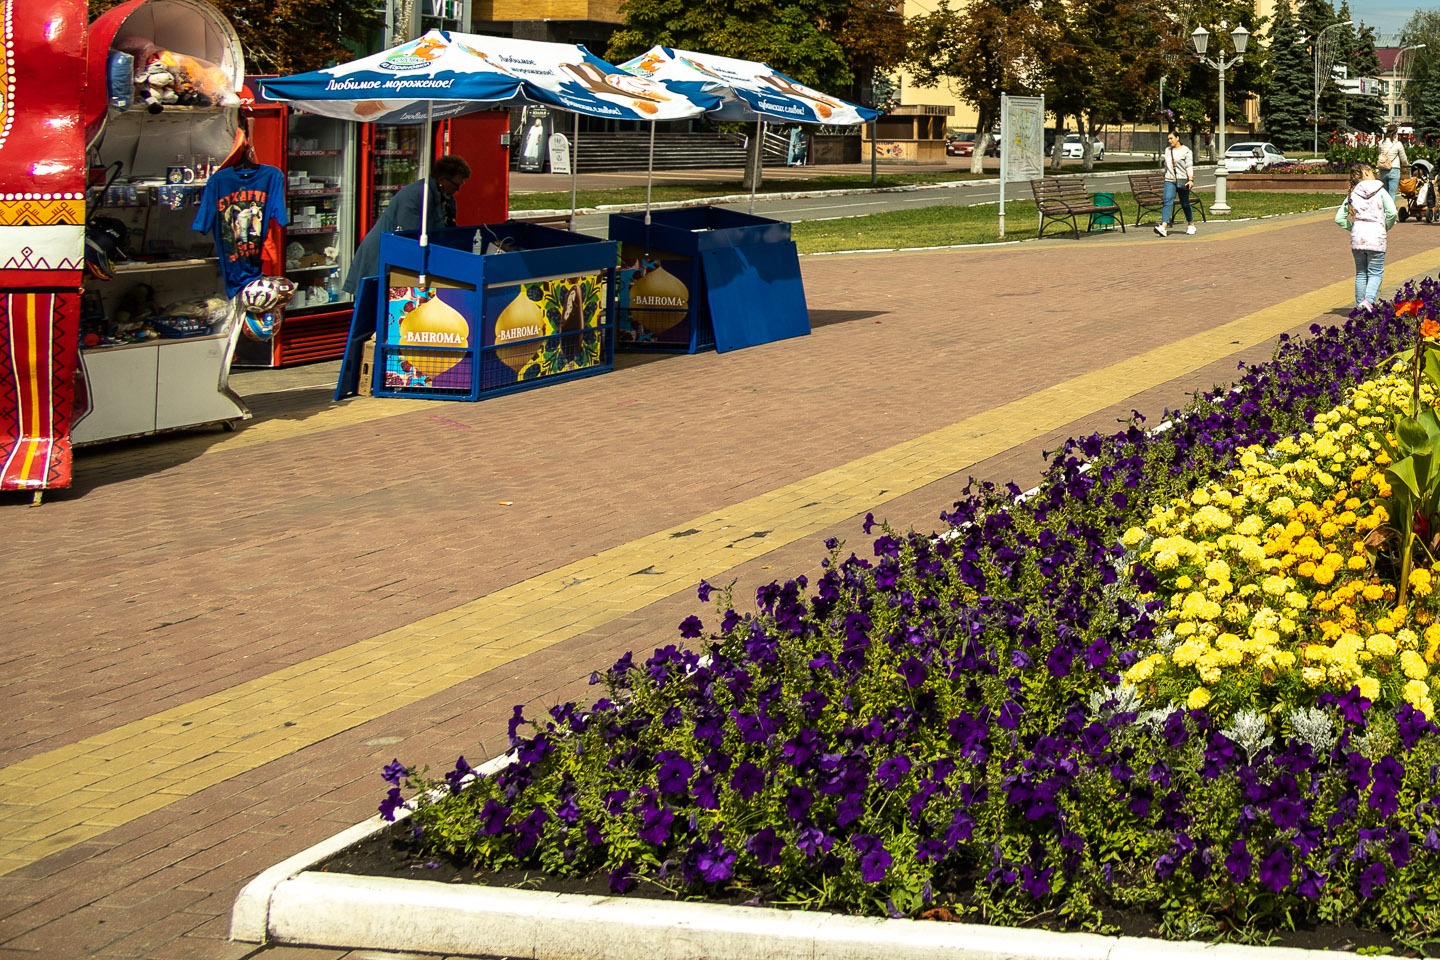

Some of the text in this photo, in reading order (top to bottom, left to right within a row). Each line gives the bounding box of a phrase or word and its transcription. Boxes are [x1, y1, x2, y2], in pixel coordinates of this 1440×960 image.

[325, 78, 455, 92] Любимое мороженое!
[636, 295, 683, 307] BAHROMA
[407, 331, 463, 344] BAHROMA
[500, 323, 539, 341] BAHROMA
